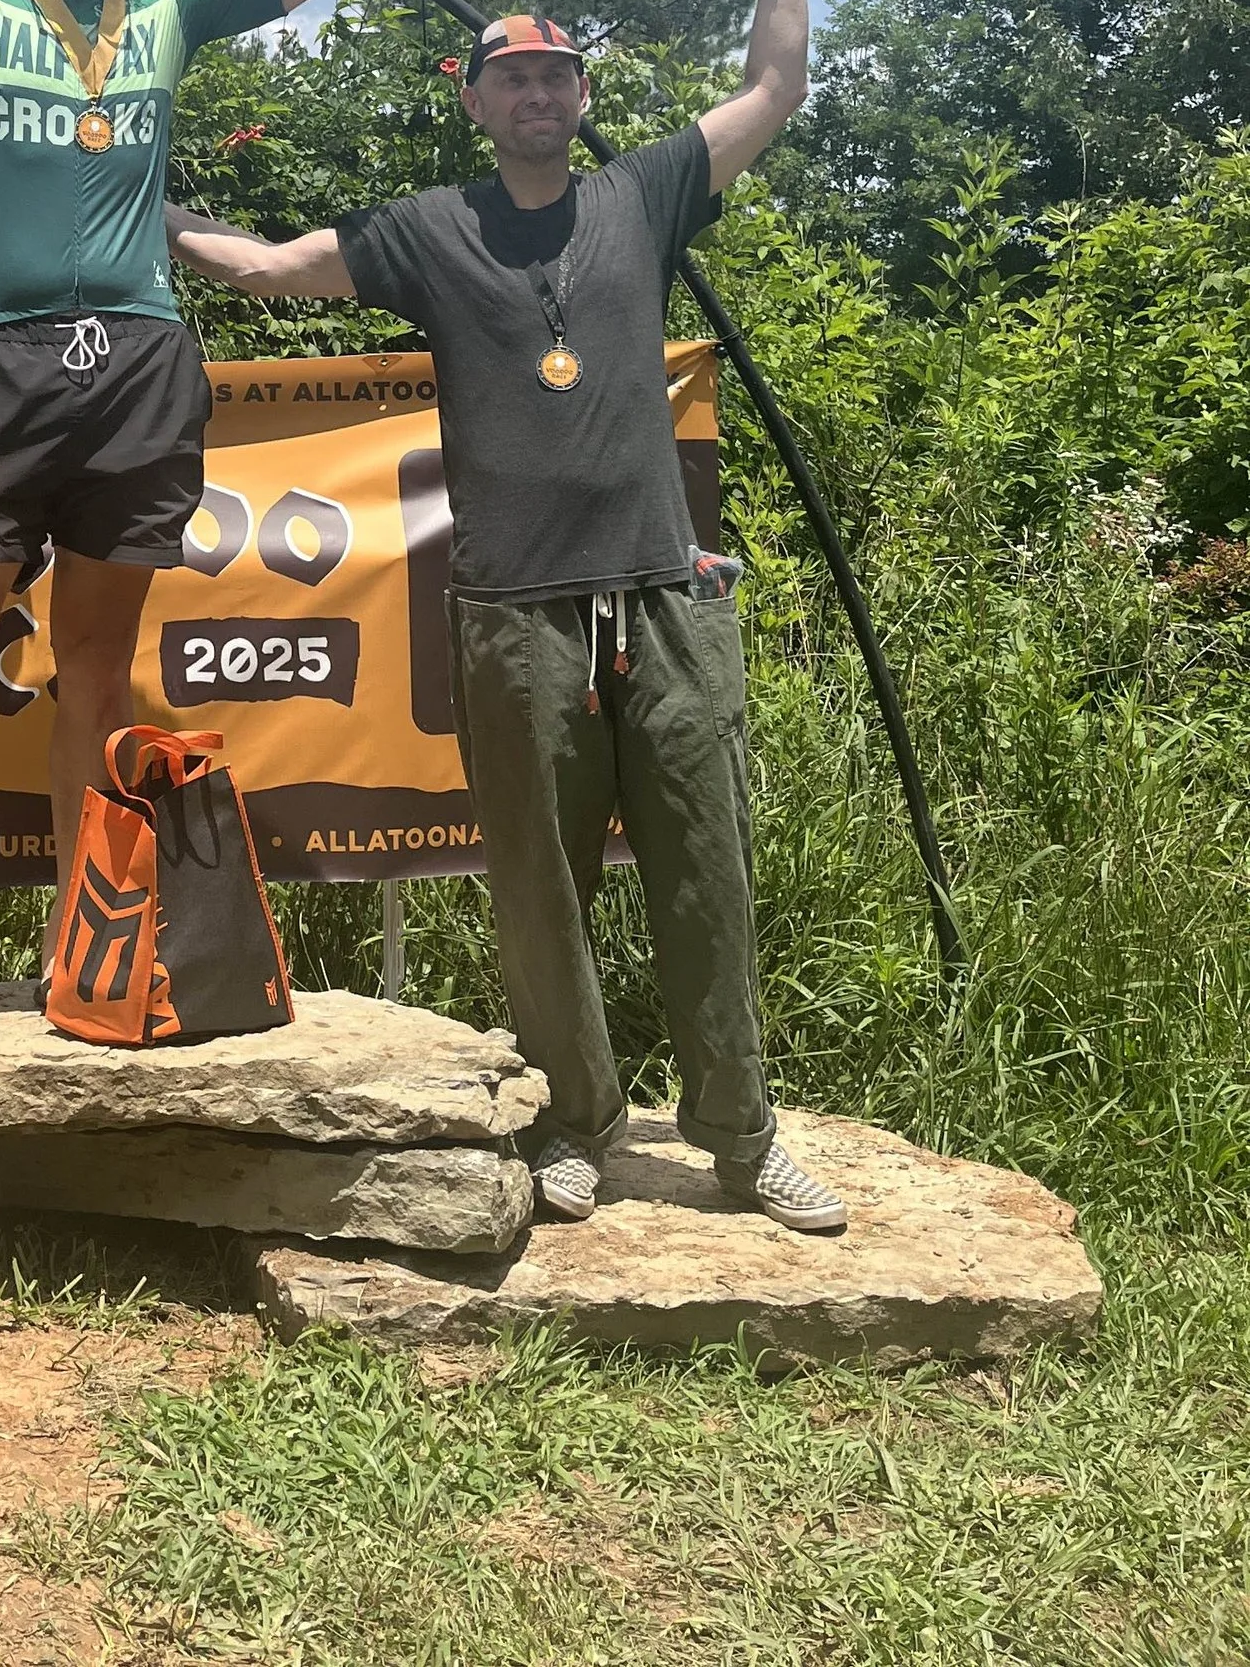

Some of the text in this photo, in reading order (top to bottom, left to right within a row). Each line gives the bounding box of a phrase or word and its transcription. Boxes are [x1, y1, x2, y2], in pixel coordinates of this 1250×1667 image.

[243, 382, 282, 403] AT
[292, 380, 437, 403] ALLATOO
[183, 636, 332, 684] 2025
[305, 822, 485, 853] ALLATOONA
